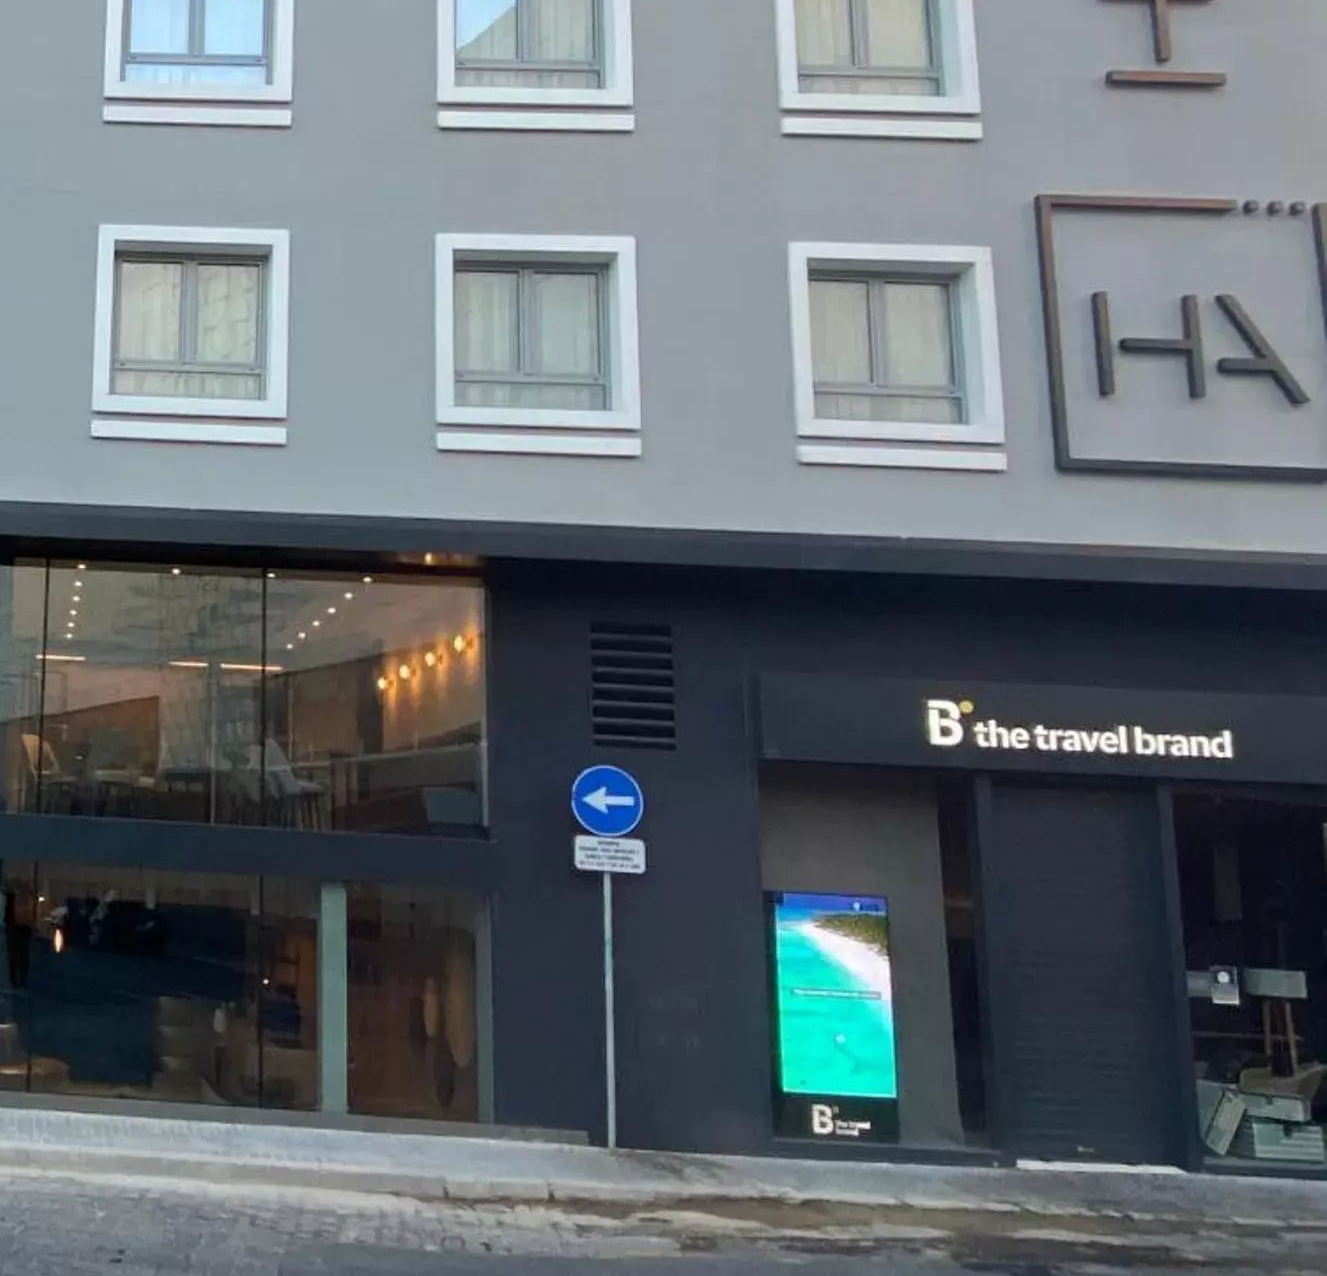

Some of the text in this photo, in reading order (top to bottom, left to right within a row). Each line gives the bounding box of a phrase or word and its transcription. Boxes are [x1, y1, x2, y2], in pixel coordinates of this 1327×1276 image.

[1090, 290, 1311, 406] HA
[974, 718, 1030, 750] the
[1033, 724, 1128, 755] travel
[1132, 725, 1235, 760] brand
